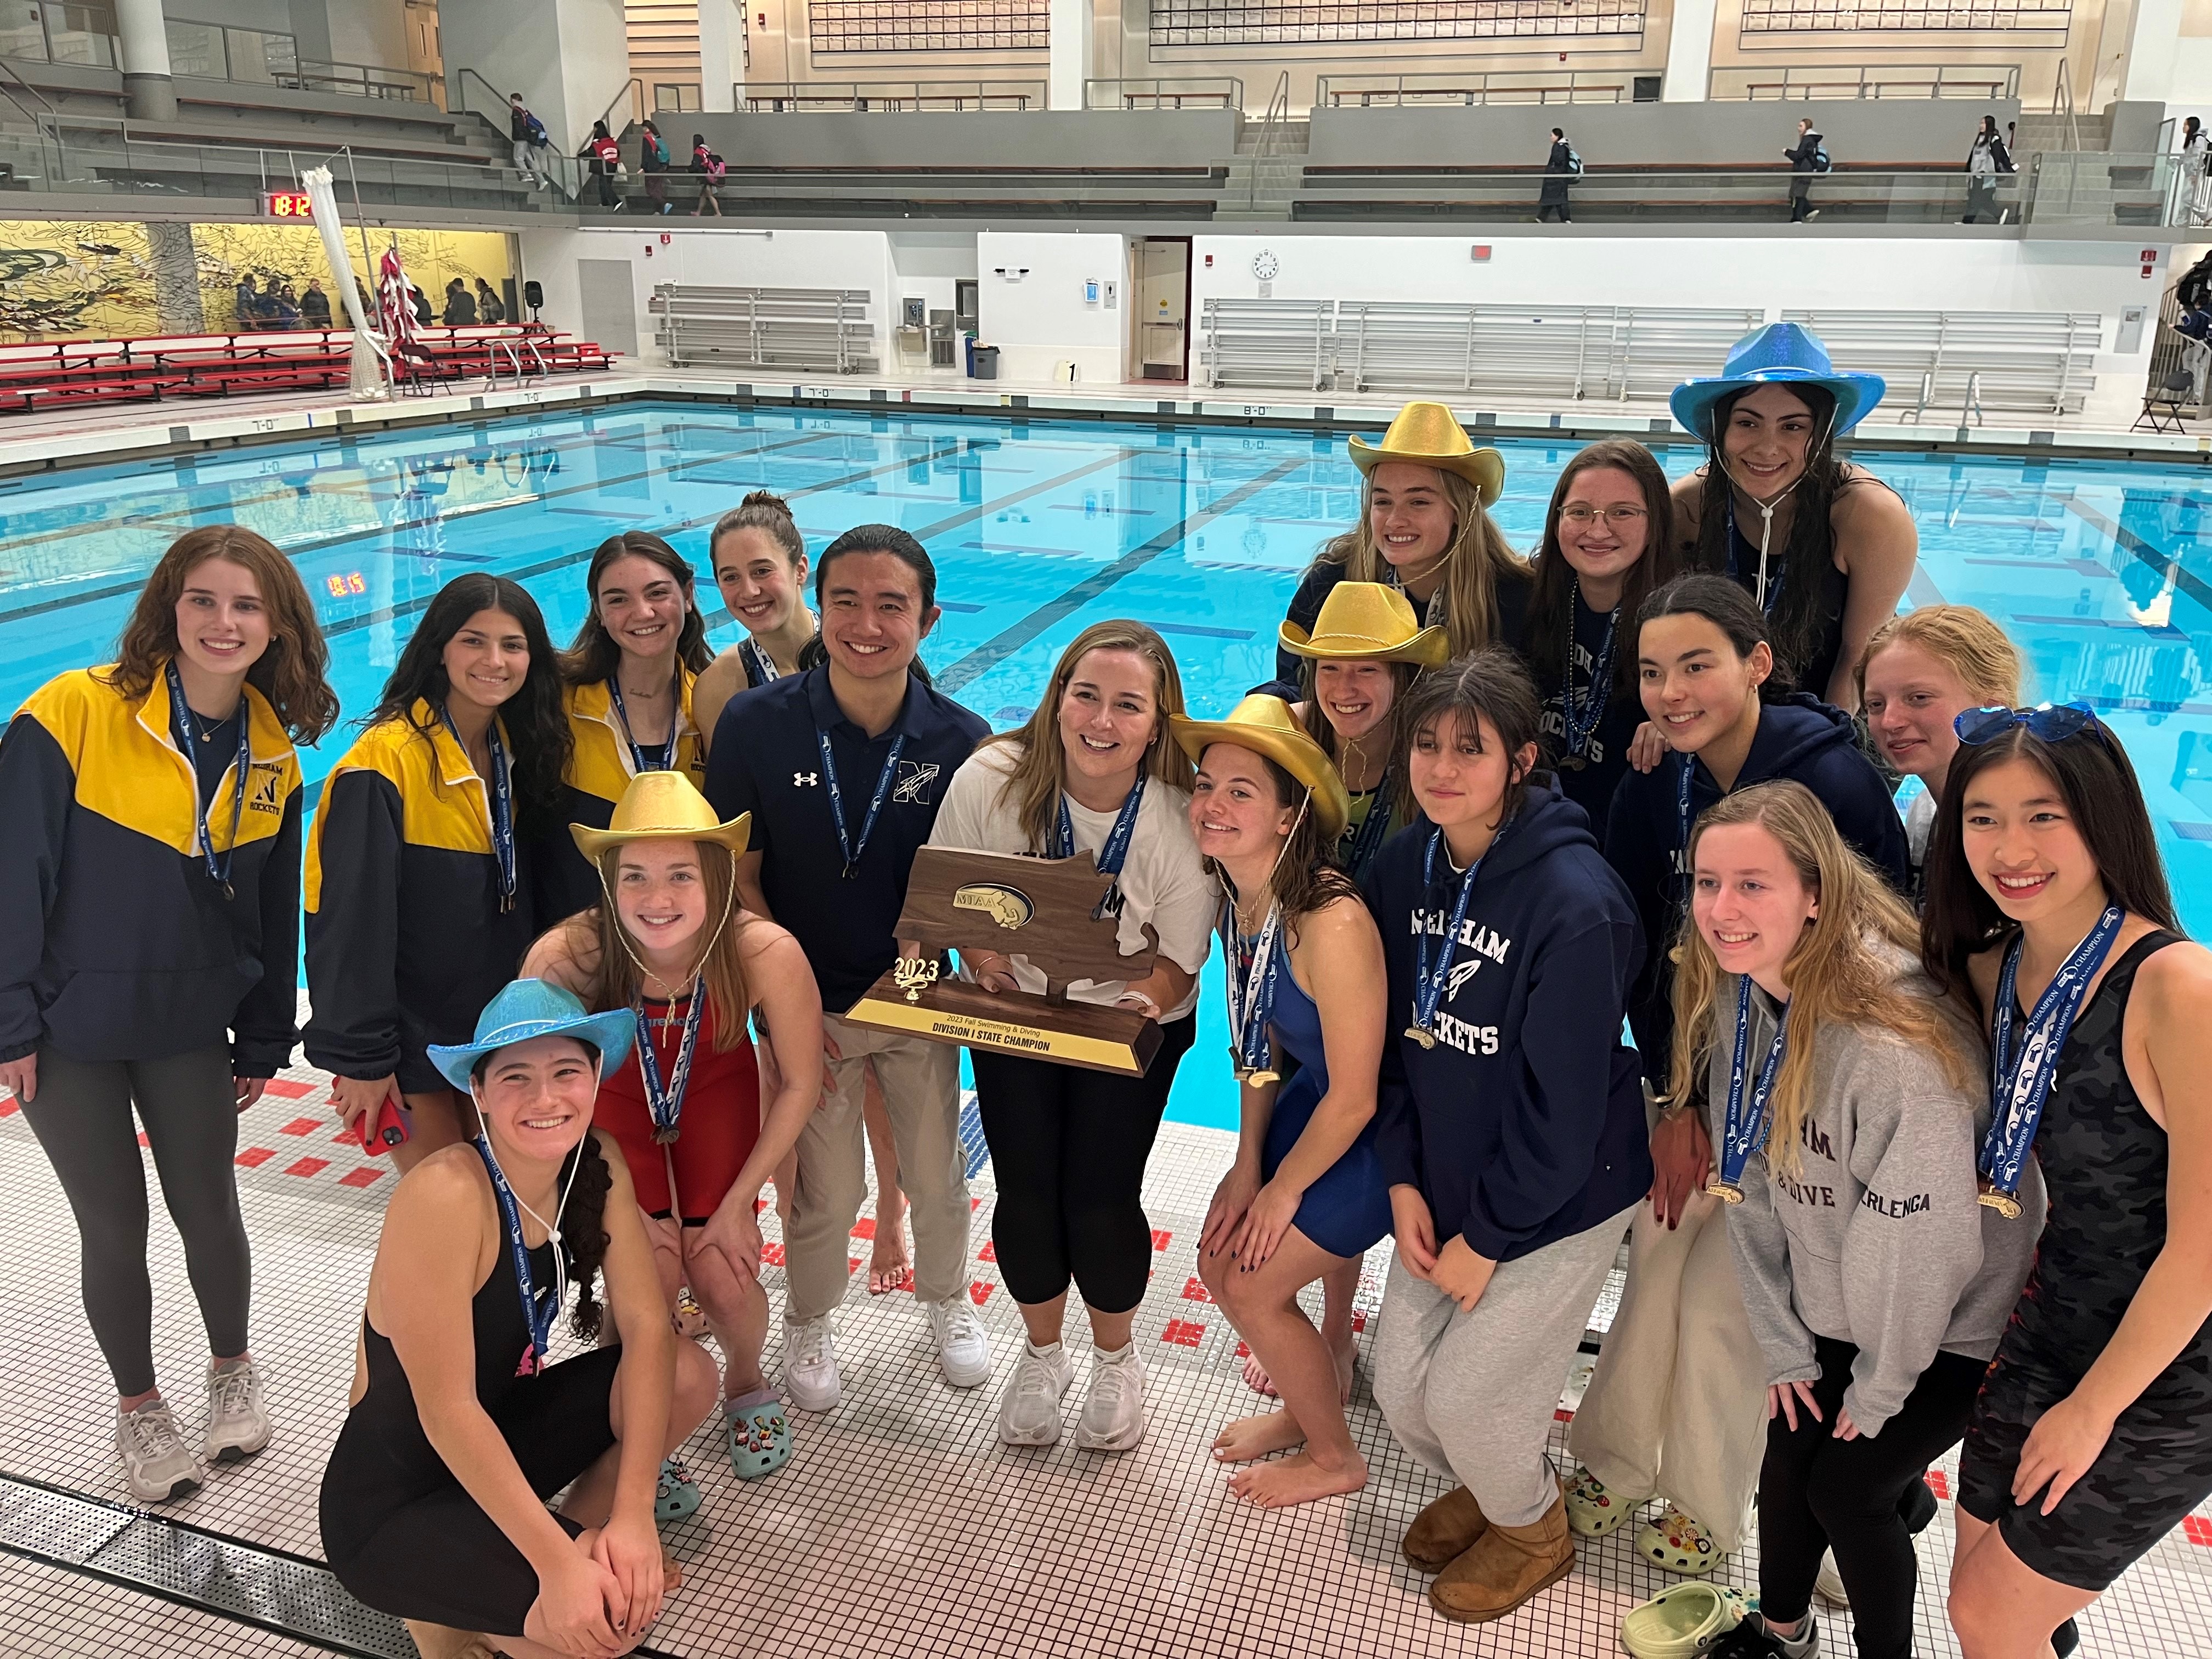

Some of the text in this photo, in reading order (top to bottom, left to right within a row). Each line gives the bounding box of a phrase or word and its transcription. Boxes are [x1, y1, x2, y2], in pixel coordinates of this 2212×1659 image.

[1069, 363, 1075, 381] 1
[826, 753, 834, 780] CHAMPION
[878, 770, 890, 796] CHAMPION
[834, 800, 843, 826] CHAMPION
[1123, 795, 1138, 822] CHAMPION
[863, 814, 874, 839] CHAMPION
[1103, 841, 1117, 867] CHAMPION
[956, 894, 996, 908] MIAA
[1455, 893, 1465, 922] CHAMPION
[1440, 942, 1451, 972] CHAMPION
[2074, 931, 2104, 967] CHAMPION
[893, 957, 939, 980] 2023
[1255, 953, 1263, 975] FINALIST
[1424, 990, 1436, 1019] CHAMPION
[2033, 990, 2058, 1023] CHAMPION
[639, 1017, 648, 1044] CHAMPION
[947, 1015, 963, 1023] 2023
[964, 1018, 976, 1026] Fall
[977, 1020, 1011, 1033] Swimming
[1020, 1027, 1041, 1038] Diving
[1413, 1001, 1498, 1054] CKETS
[2054, 1003, 2072, 1041] CHAMPION
[933, 1023, 1051, 1051] DIVISION I STATE CHAMPION
[649, 1063, 659, 1090] CHAMPION
[1762, 1058, 1775, 1088] CHAMPION
[2011, 1044, 2024, 1080] CHAMPION
[2033, 1066, 2048, 1103] CHAMPION
[1745, 1108, 1758, 1138] CHAMPION
[2013, 1126, 2029, 1161] CHAMPION
[1788, 1174, 1836, 1209] DIVE
[505, 1194, 517, 1226] CHAMPION
[517, 1246, 527, 1277] CHAMPION
[541, 1299, 556, 1328] CHAMPION
